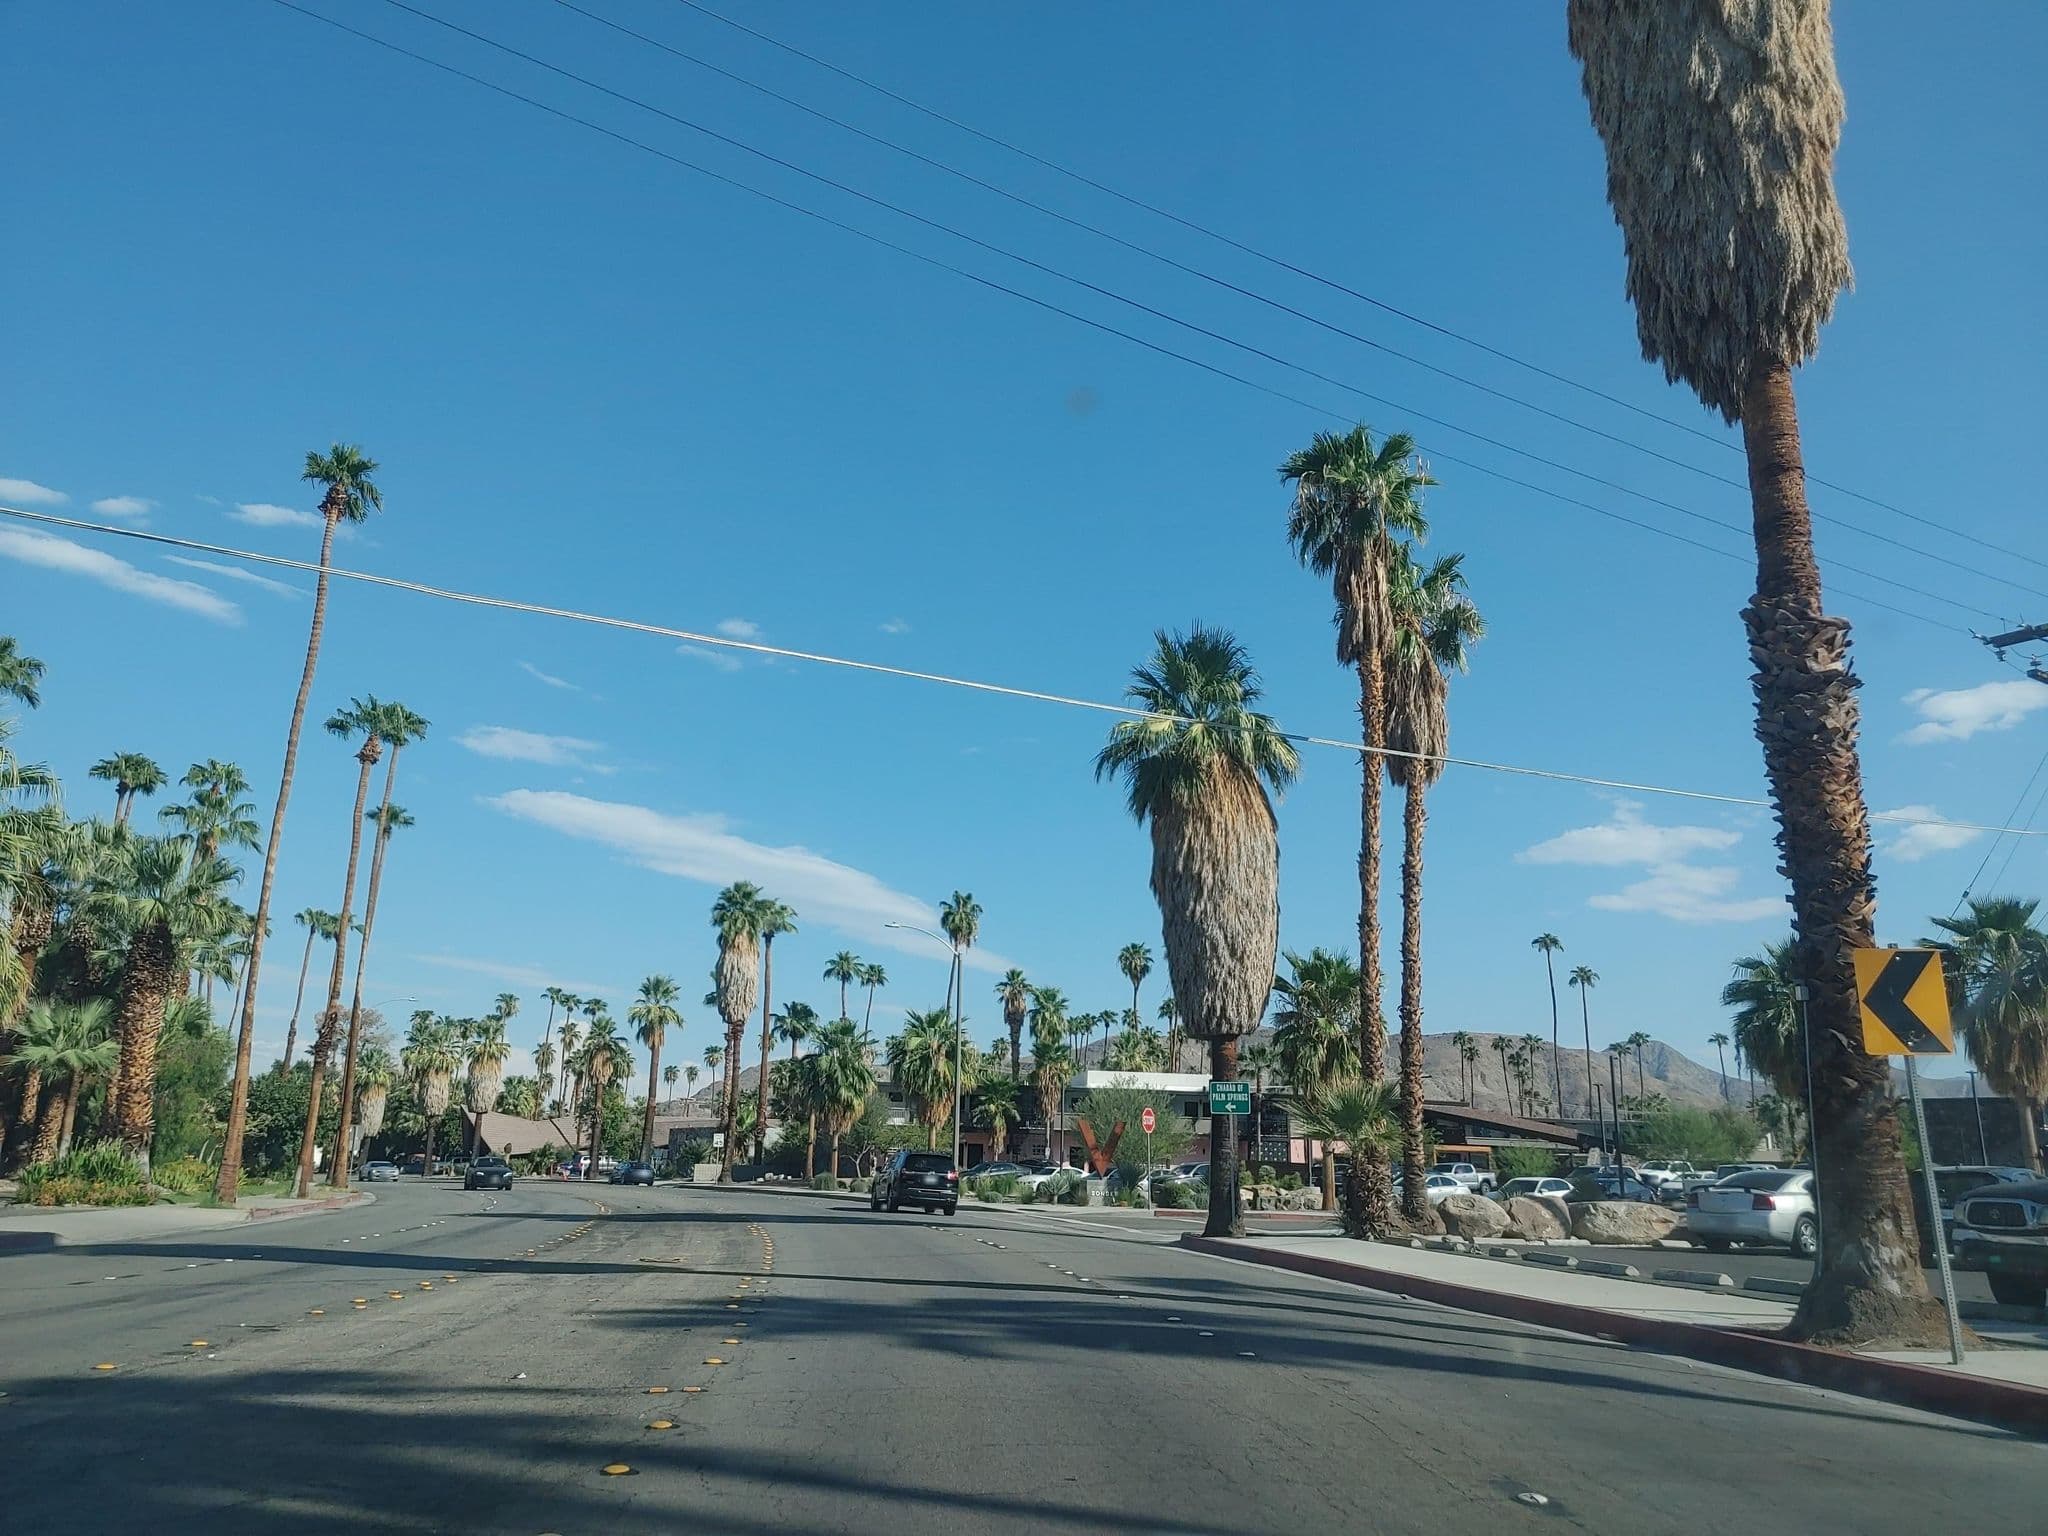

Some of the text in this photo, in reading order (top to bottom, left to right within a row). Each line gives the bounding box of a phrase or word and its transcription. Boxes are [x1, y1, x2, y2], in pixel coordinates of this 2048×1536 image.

[1216, 1083, 1244, 1092] CHABAD OF
[1212, 1093, 1249, 1101] PALM SPRINGS
[1142, 1115, 1154, 1125] STOP
